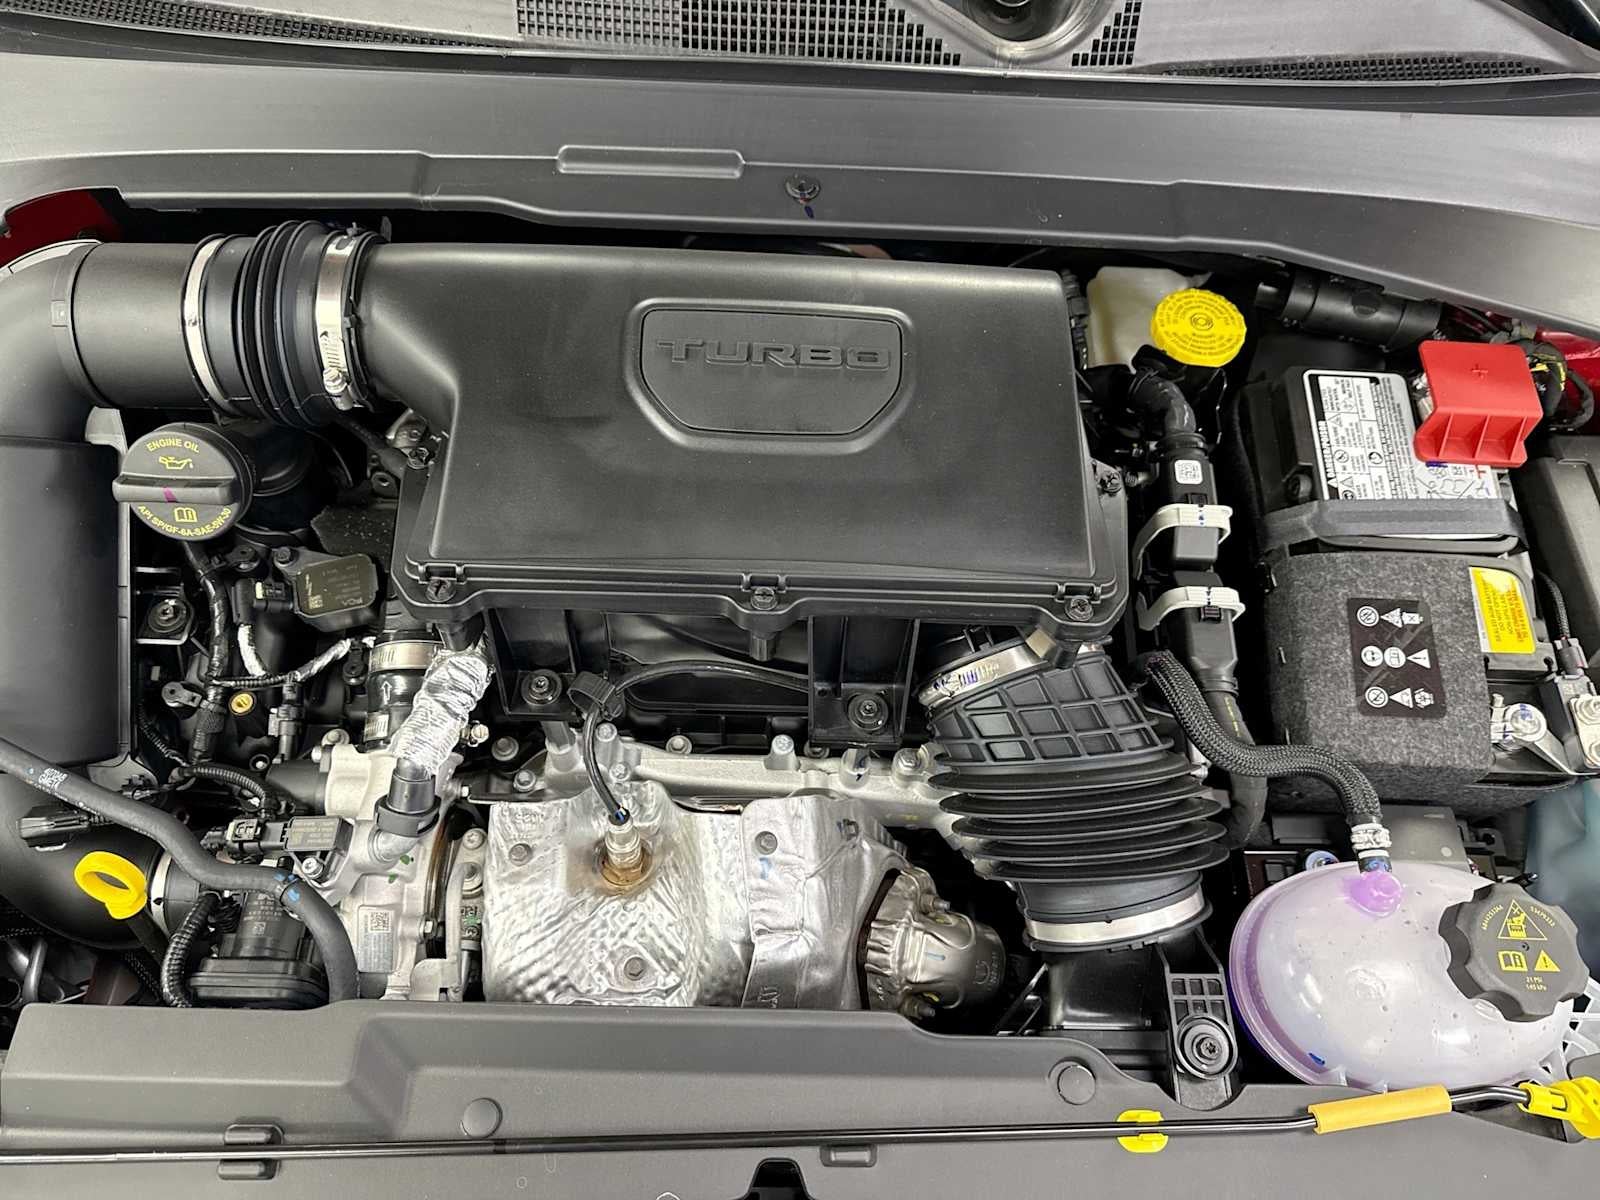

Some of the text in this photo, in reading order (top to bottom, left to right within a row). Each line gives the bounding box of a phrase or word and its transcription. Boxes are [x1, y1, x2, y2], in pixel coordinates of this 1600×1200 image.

[656, 338, 889, 371] TURBO
[146, 438, 201, 453] ENGINE OIL
[137, 505, 153, 520] API
